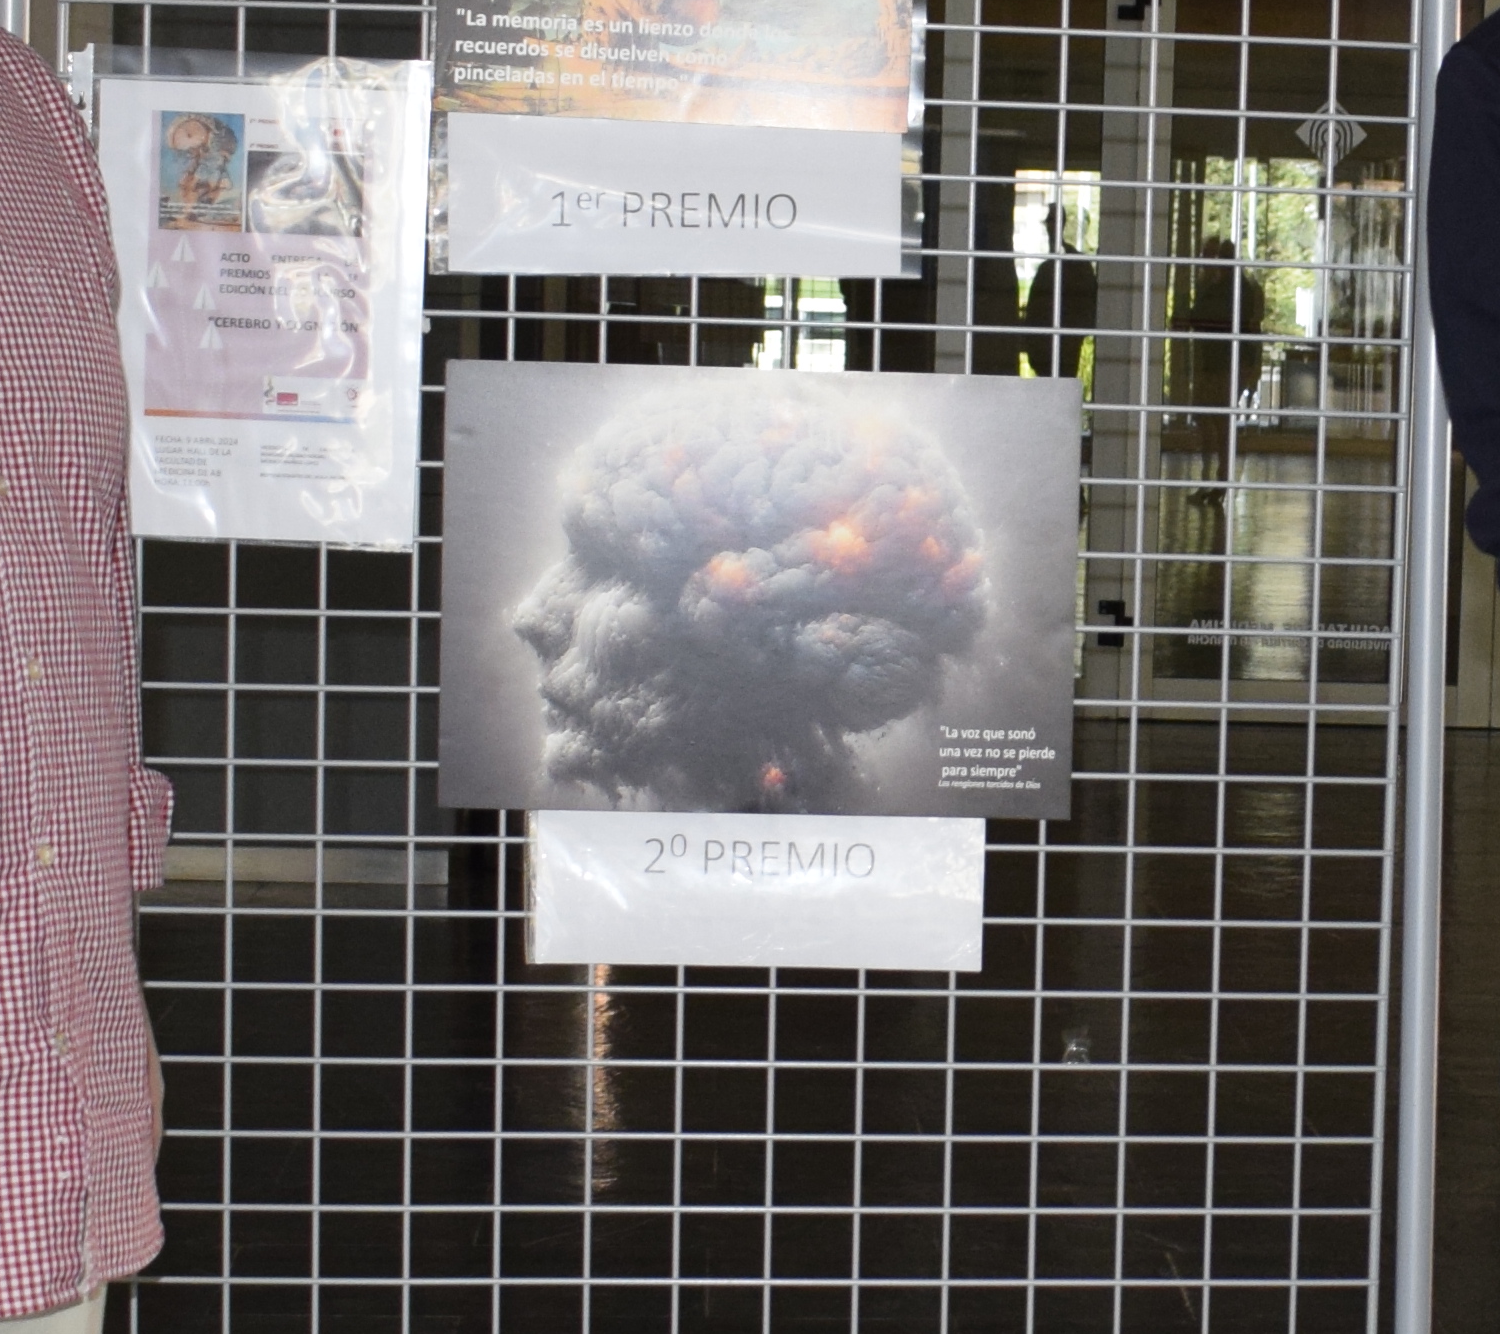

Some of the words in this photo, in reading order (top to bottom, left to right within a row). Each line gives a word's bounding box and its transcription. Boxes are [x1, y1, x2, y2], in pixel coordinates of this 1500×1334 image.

[492, 12, 577, 31] memoria
[584, 20, 604, 33] es
[609, 21, 633, 34] un
[639, 18, 694, 38] lienzo
[455, 38, 549, 58] recuerdos
[555, 45, 575, 59] se
[580, 42, 671, 63] disuelven
[454, 63, 555, 86] pinceladas
[560, 71, 584, 86] en
[589, 69, 605, 86] el
[550, 190, 606, 229] 1er
[622, 192, 798, 231] PREMIO
[220, 253, 251, 263] ACTO
[961, 729, 980, 739] voz
[983, 729, 1005, 741] que
[1008, 727, 1036, 740] sonó
[940, 748, 961, 757] una
[963, 748, 983, 758] vez
[985, 748, 1001, 758] no
[1003, 749, 1016, 759] se
[1019, 747, 1056, 761] pierde
[942, 766, 968, 778] para
[703, 840, 876, 880] PREMIO
